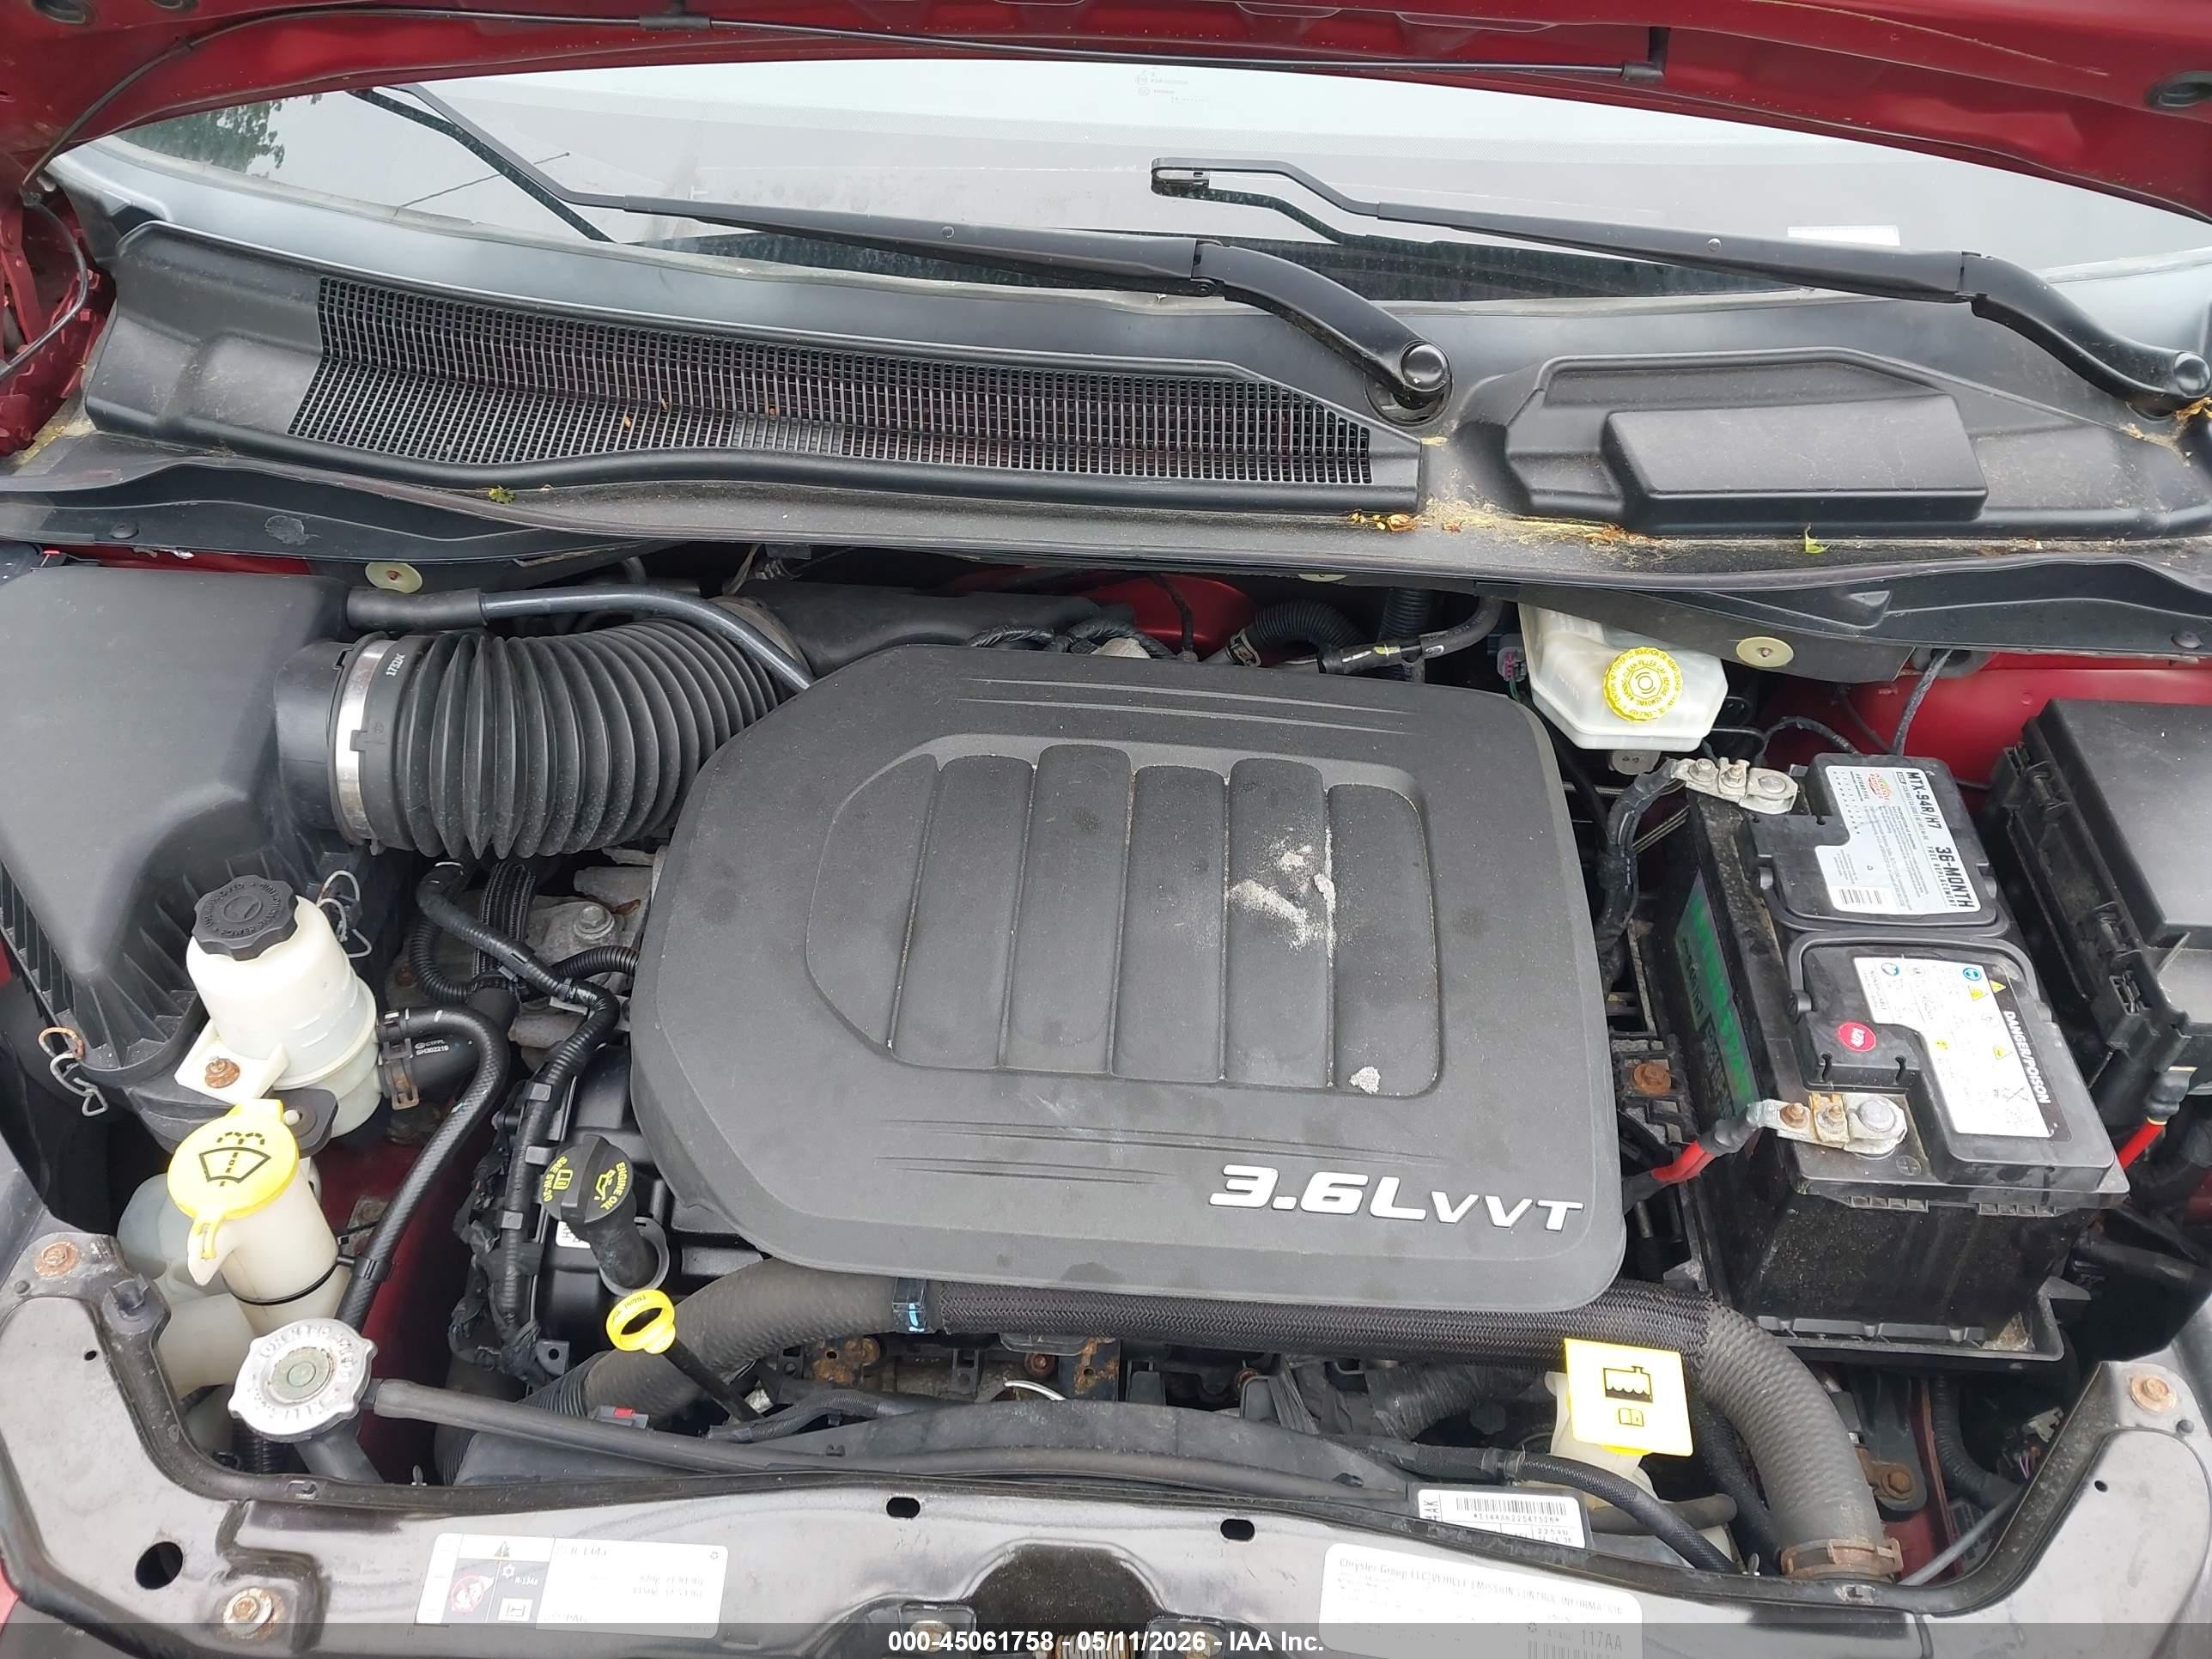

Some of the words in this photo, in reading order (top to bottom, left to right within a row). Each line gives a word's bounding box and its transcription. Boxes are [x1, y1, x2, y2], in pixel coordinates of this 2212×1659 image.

[1622, 662, 1638, 678] CLEAN
[1635, 696, 1663, 707] REMOVING
[1906, 771, 1942, 830] MTX-94R/H7
[1927, 847, 1938, 861] FREE
[1933, 863, 1957, 908] REPLACEMENT
[1935, 847, 1976, 908] 36-MONTH
[2003, 1010, 2051, 1104] DANGER/POISON
[542, 1173, 556, 1202] 5W-20
[552, 1156, 568, 1175] SAE
[614, 1162, 627, 1196] ENGINE
[599, 1192, 619, 1211] OIL
[1339, 1557, 1376, 1573] Chrysler
[1380, 1564, 1407, 1580] Group
[1471, 1579, 1514, 1596] EMISSION
[1516, 1586, 1556, 1604] CONTROL
